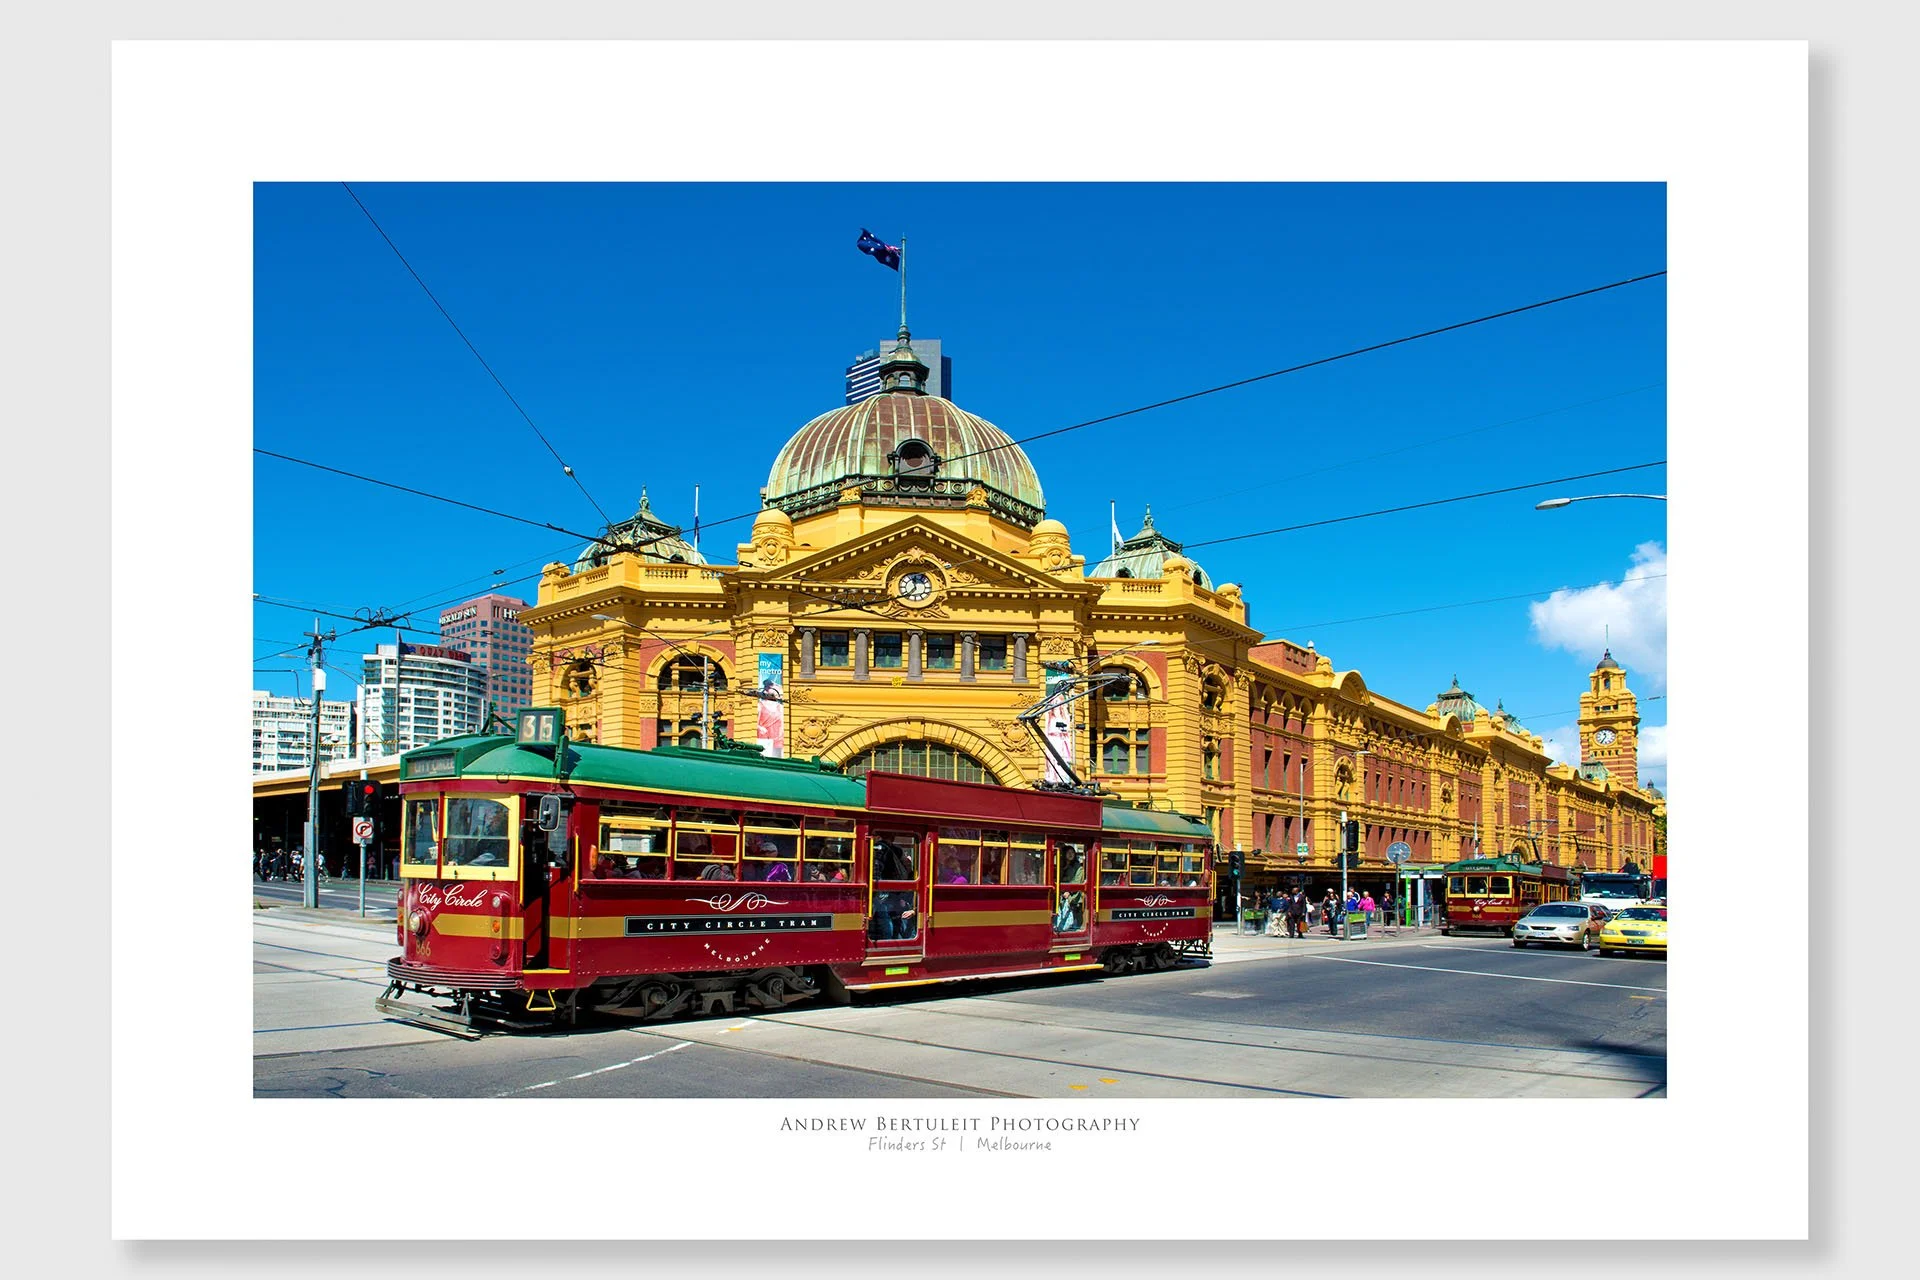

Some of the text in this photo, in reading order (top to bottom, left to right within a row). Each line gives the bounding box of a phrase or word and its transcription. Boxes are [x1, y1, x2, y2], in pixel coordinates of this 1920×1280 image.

[759, 660, 771, 668] my
[523, 714, 554, 738] 35
[418, 882, 489, 911] City Circle
[647, 919, 818, 930] CITY CIRCLE TRAM
[703, 938, 771, 963] MELBOURNE
